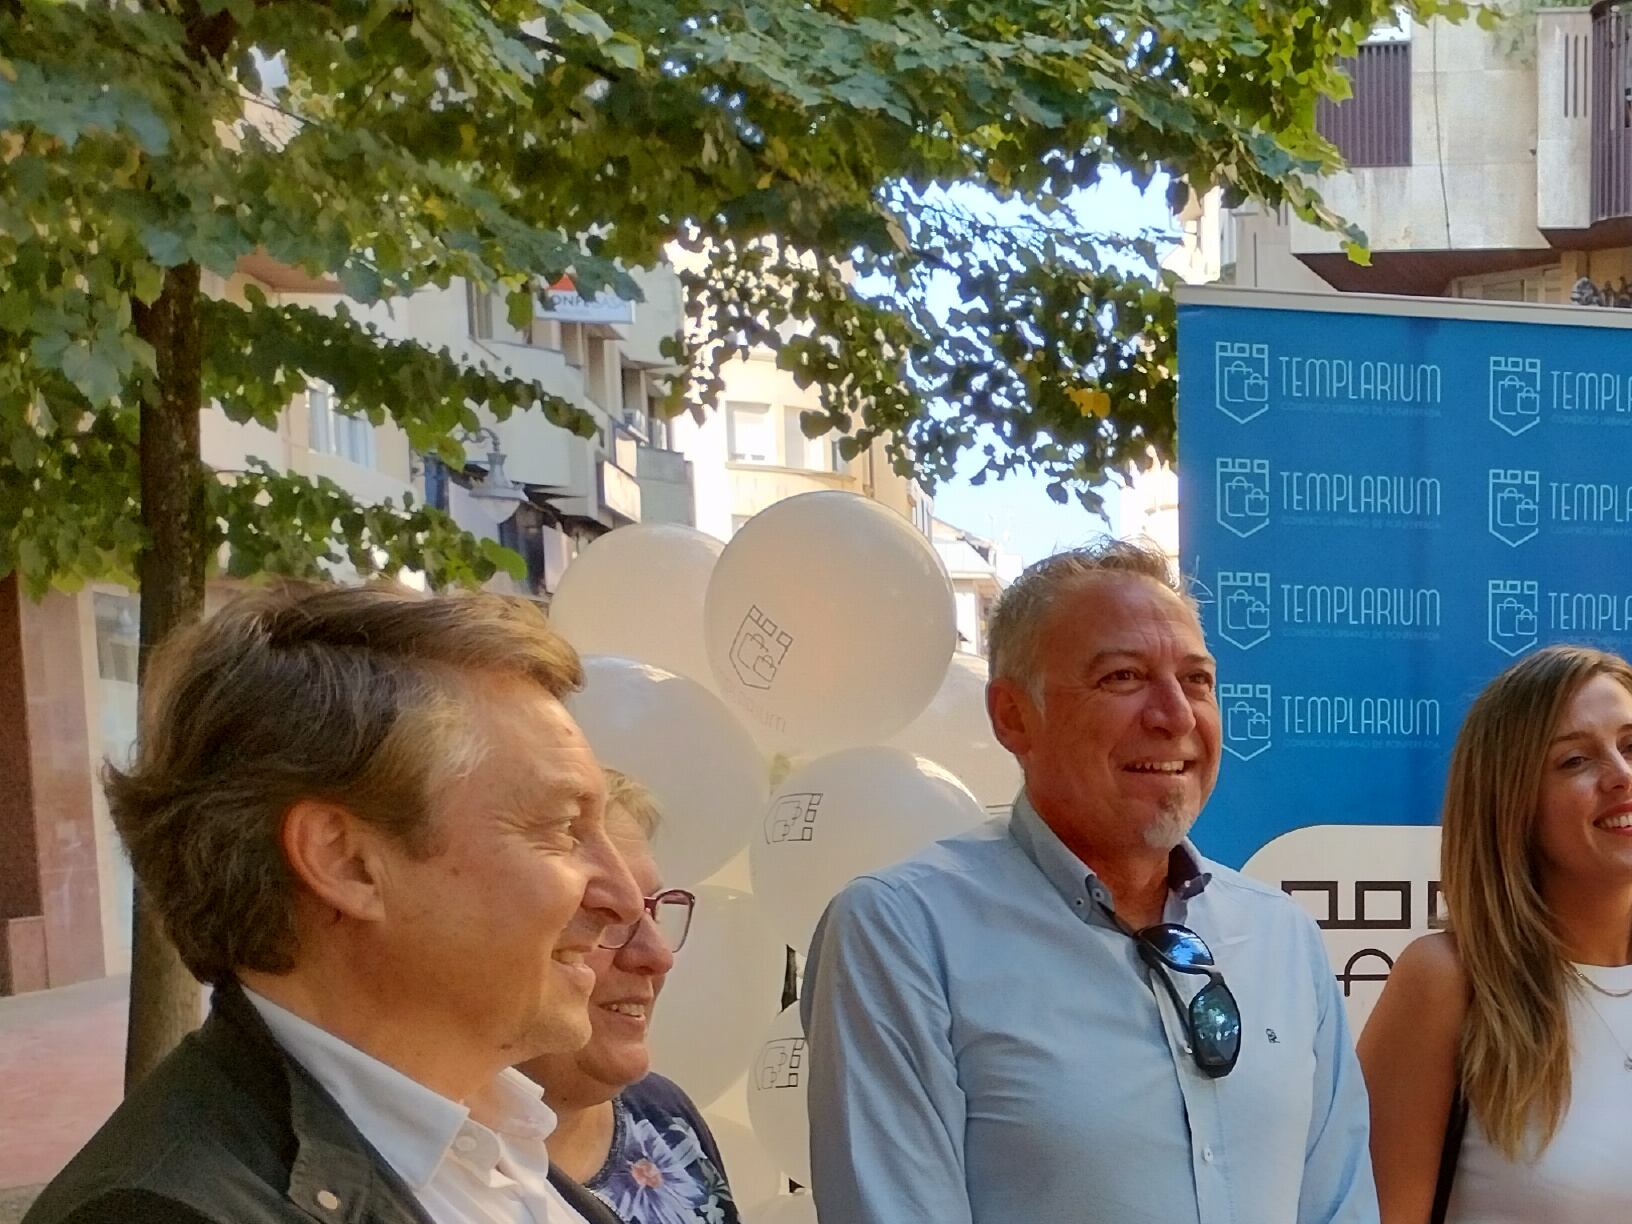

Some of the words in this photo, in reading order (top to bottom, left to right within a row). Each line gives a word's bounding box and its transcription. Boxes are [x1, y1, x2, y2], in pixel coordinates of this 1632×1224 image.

[1279, 356, 1441, 403] TEMPLARIUM
[1280, 472, 1441, 516] TEMPLARIUM
[1281, 584, 1441, 626] TEMPLARIUM
[1281, 696, 1440, 735] TEMPLARIUM
